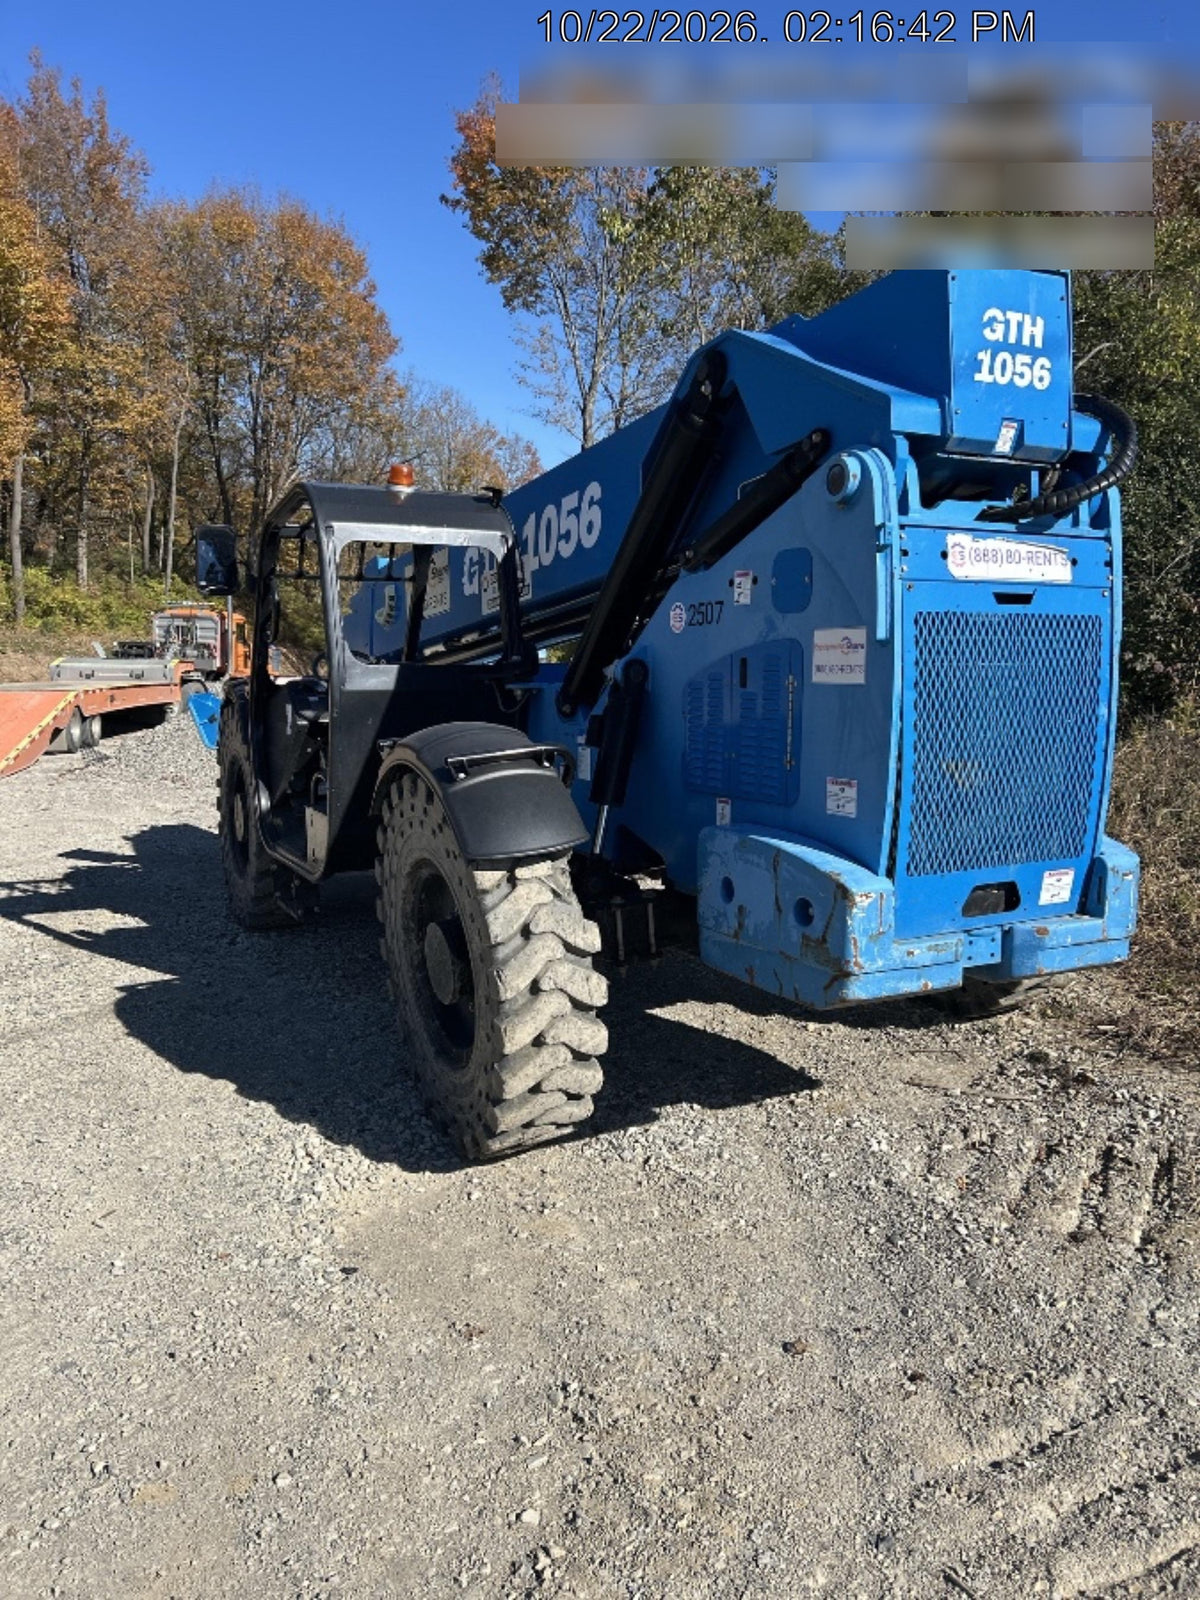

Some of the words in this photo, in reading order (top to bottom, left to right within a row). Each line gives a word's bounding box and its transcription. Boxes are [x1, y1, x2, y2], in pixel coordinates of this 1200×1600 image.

[981, 307, 1045, 349] GTH
[973, 349, 1052, 391] 1056
[521, 481, 602, 571] 1056
[687, 600, 725, 627] 2507
